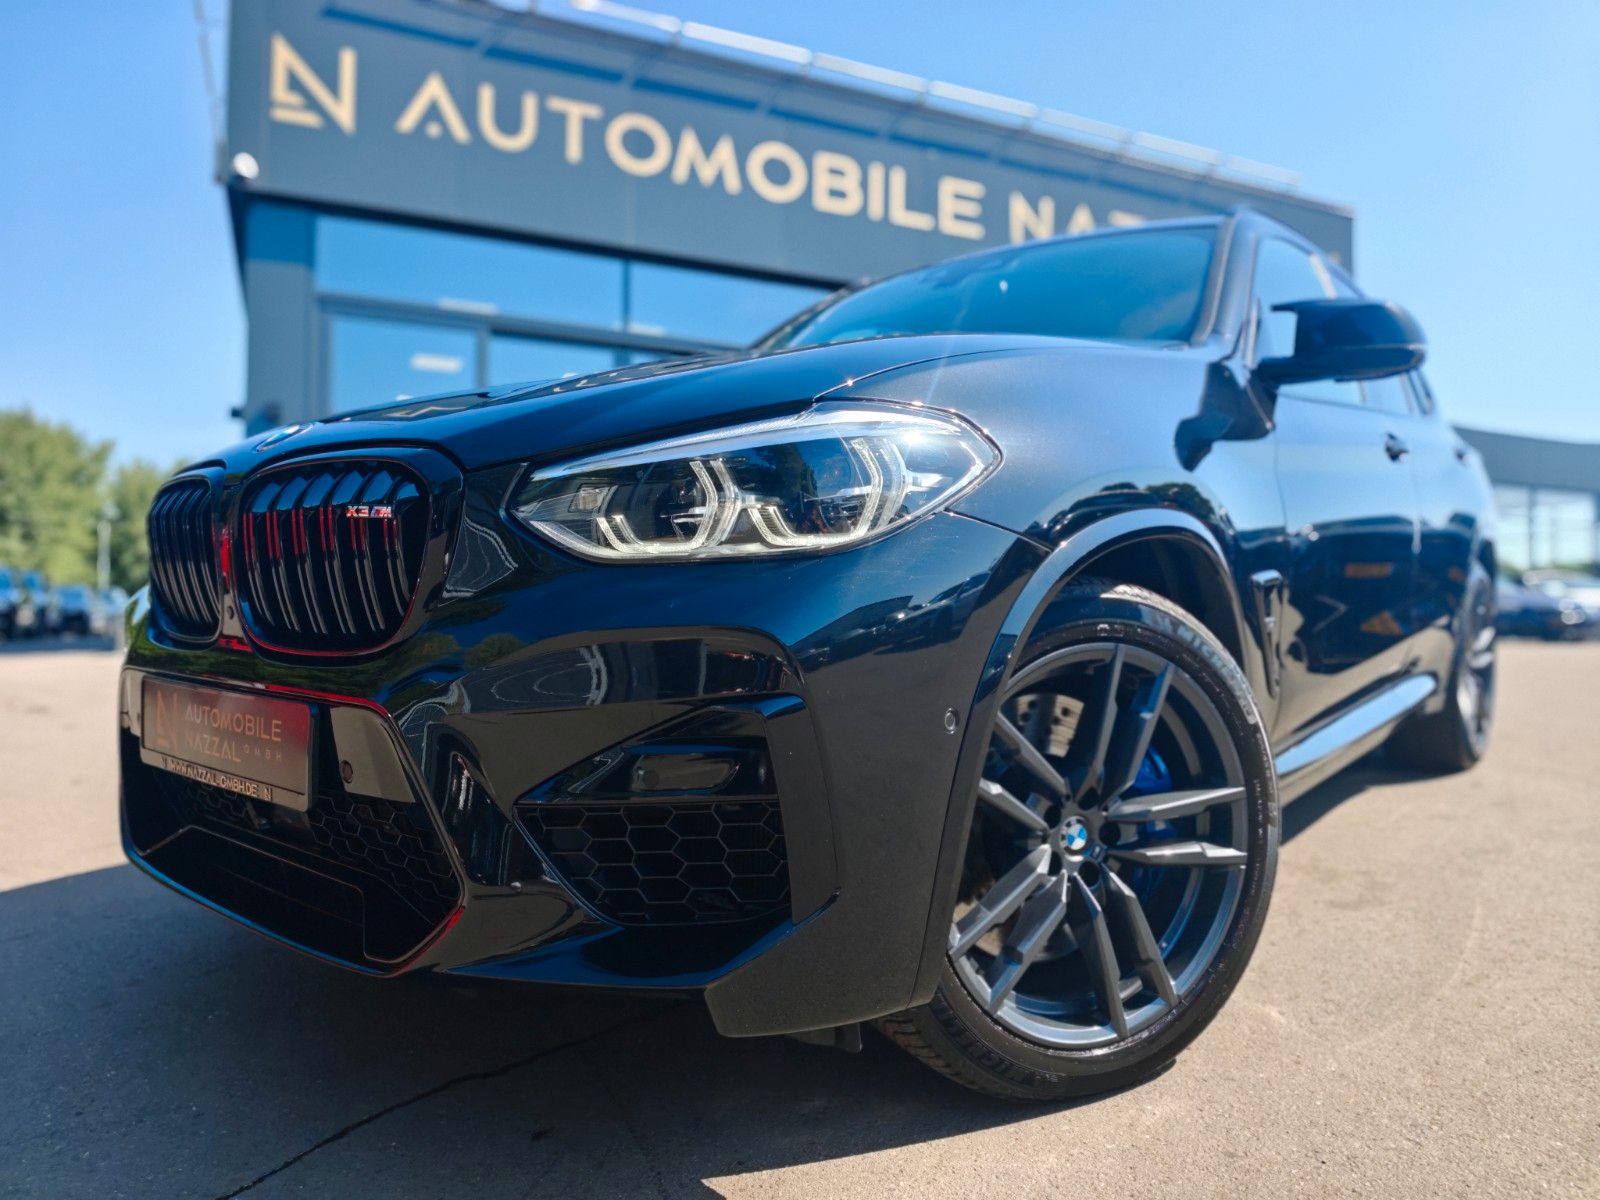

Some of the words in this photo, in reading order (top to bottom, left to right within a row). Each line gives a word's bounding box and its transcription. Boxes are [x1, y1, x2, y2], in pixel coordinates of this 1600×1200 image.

[395, 71, 985, 240] AUTOMOBILE
[184, 703, 283, 742] AUTOMOBILE
[185, 732, 242, 762] NAZZAL
